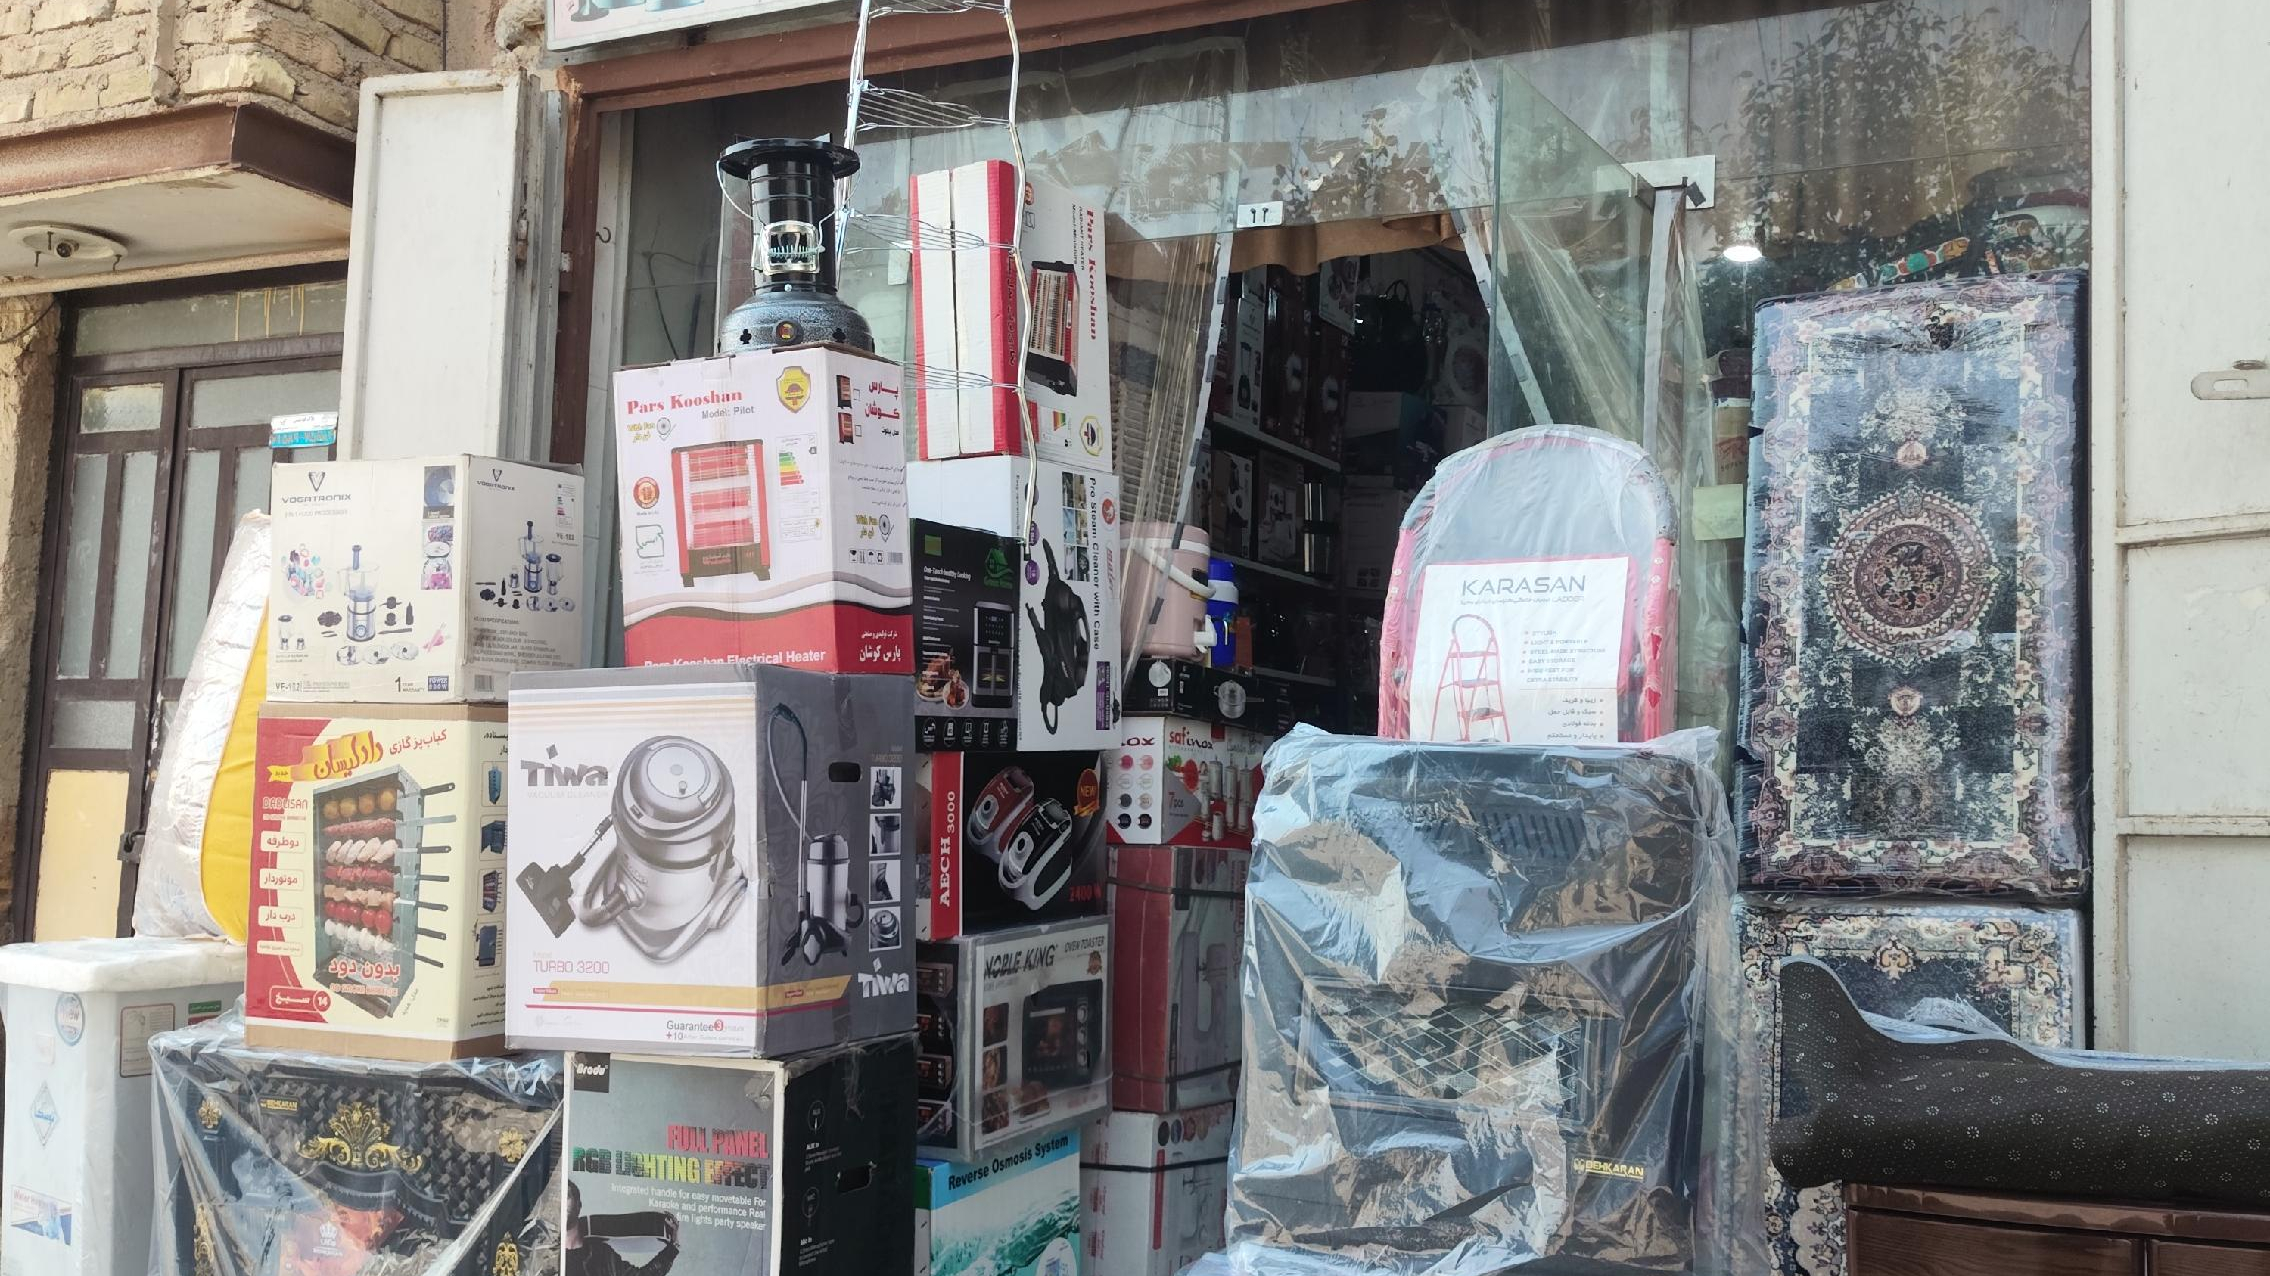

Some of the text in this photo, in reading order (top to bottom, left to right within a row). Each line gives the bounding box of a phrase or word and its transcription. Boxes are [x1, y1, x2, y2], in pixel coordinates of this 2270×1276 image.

[1086, 210, 1097, 341] Pars Kooshan
[868, 381, 899, 401] پارس
[626, 390, 743, 415] Pars Kooshan
[701, 405, 755, 420] Model: Pilot
[864, 400, 900, 420] کوشان
[281, 493, 352, 504] VOGATRONIX
[1089, 477, 1101, 651] Pro Steam Cleaner with Case
[1461, 574, 1586, 597] KARASAN
[785, 650, 827, 664] Heater
[859, 644, 901, 662] پارس کوشان
[395, 676, 401, 693] 1
[313, 730, 384, 780] دادلیسان
[1080, 785, 1097, 798] NEW
[938, 790, 956, 907] AECH 3000
[532, 959, 610, 974] TURBO 3200
[1022, 944, 1055, 971] KING
[328, 957, 401, 982] بدون دود
[666, 1020, 714, 1032] Guarantee
[668, 1124, 769, 1159] FULL PANEL
[572, 1146, 770, 1189] RGB LIGHTING EFFECT
[948, 1134, 1070, 1191] Reverse Osmosis System
[611, 1183, 649, 1196] Integrated
[650, 1187, 677, 1198] handle
[678, 1189, 690, 1199] for
[691, 1193, 711, 1204] easy
[753, 1196, 767, 1207] For
[648, 1198, 766, 1219] Karaoke and performance Real
[714, 1215, 735, 1229] party
[735, 1219, 767, 1231] speaker
